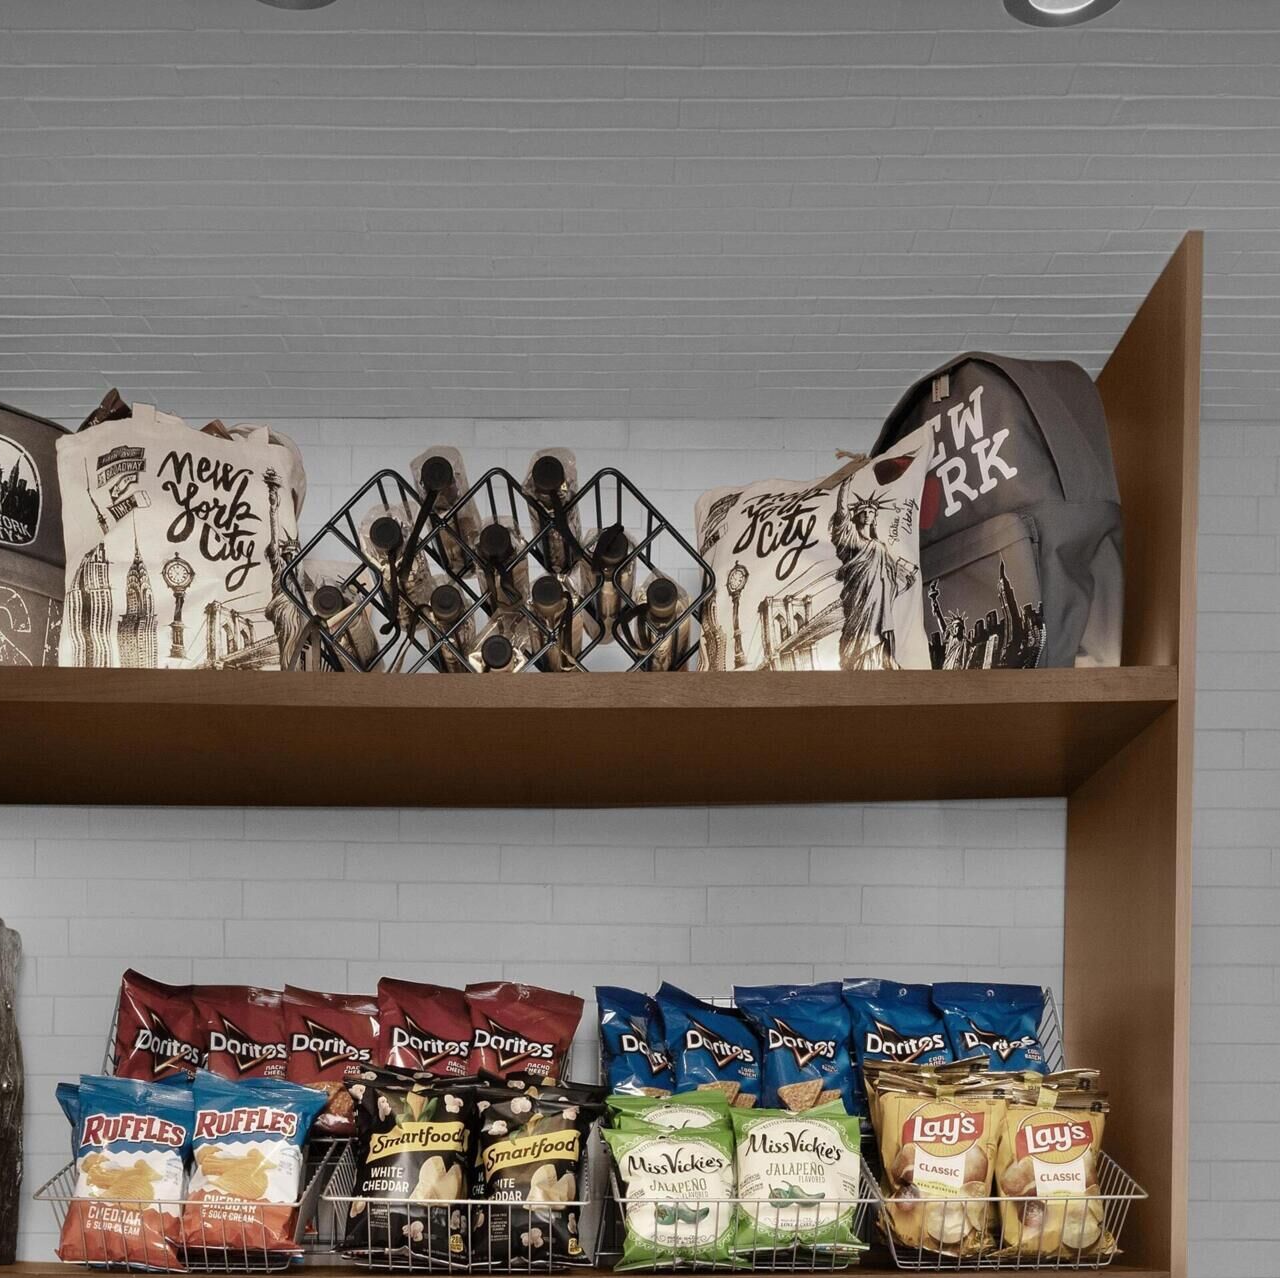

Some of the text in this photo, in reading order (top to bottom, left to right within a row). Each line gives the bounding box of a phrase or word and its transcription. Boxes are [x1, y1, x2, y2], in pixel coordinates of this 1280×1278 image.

[112, 499, 134, 520] TIMES
[757, 509, 819, 580] City
[199, 528, 260, 591] City
[135, 1029, 200, 1065] Doritos
[210, 1032, 288, 1060] Doritos
[293, 1034, 370, 1061] Doritos
[393, 1028, 470, 1057] Doritos
[474, 1029, 555, 1058] Doritos
[686, 1029, 754, 1064] Doritos
[768, 1028, 836, 1060] Doritos
[866, 1032, 945, 1056] Doritos
[372, 1126, 465, 1154] Smartfood
[913, 1112, 979, 1144] Lay's
[1024, 1122, 1090, 1154] Lay's
[486, 1136, 577, 1171] Smartfood
[745, 1128, 843, 1165] Miss Vickie's
[370, 1166, 404, 1179] WHITE
[627, 1147, 724, 1176] Miss Vickie's
[765, 1162, 825, 1177] JALAPEÑO
[919, 1162, 960, 1177] CLASSIC
[362, 1178, 410, 1194] CHEDDAR
[649, 1177, 708, 1194] JALAPEÑO
[1040, 1171, 1081, 1182] CLASSIC
